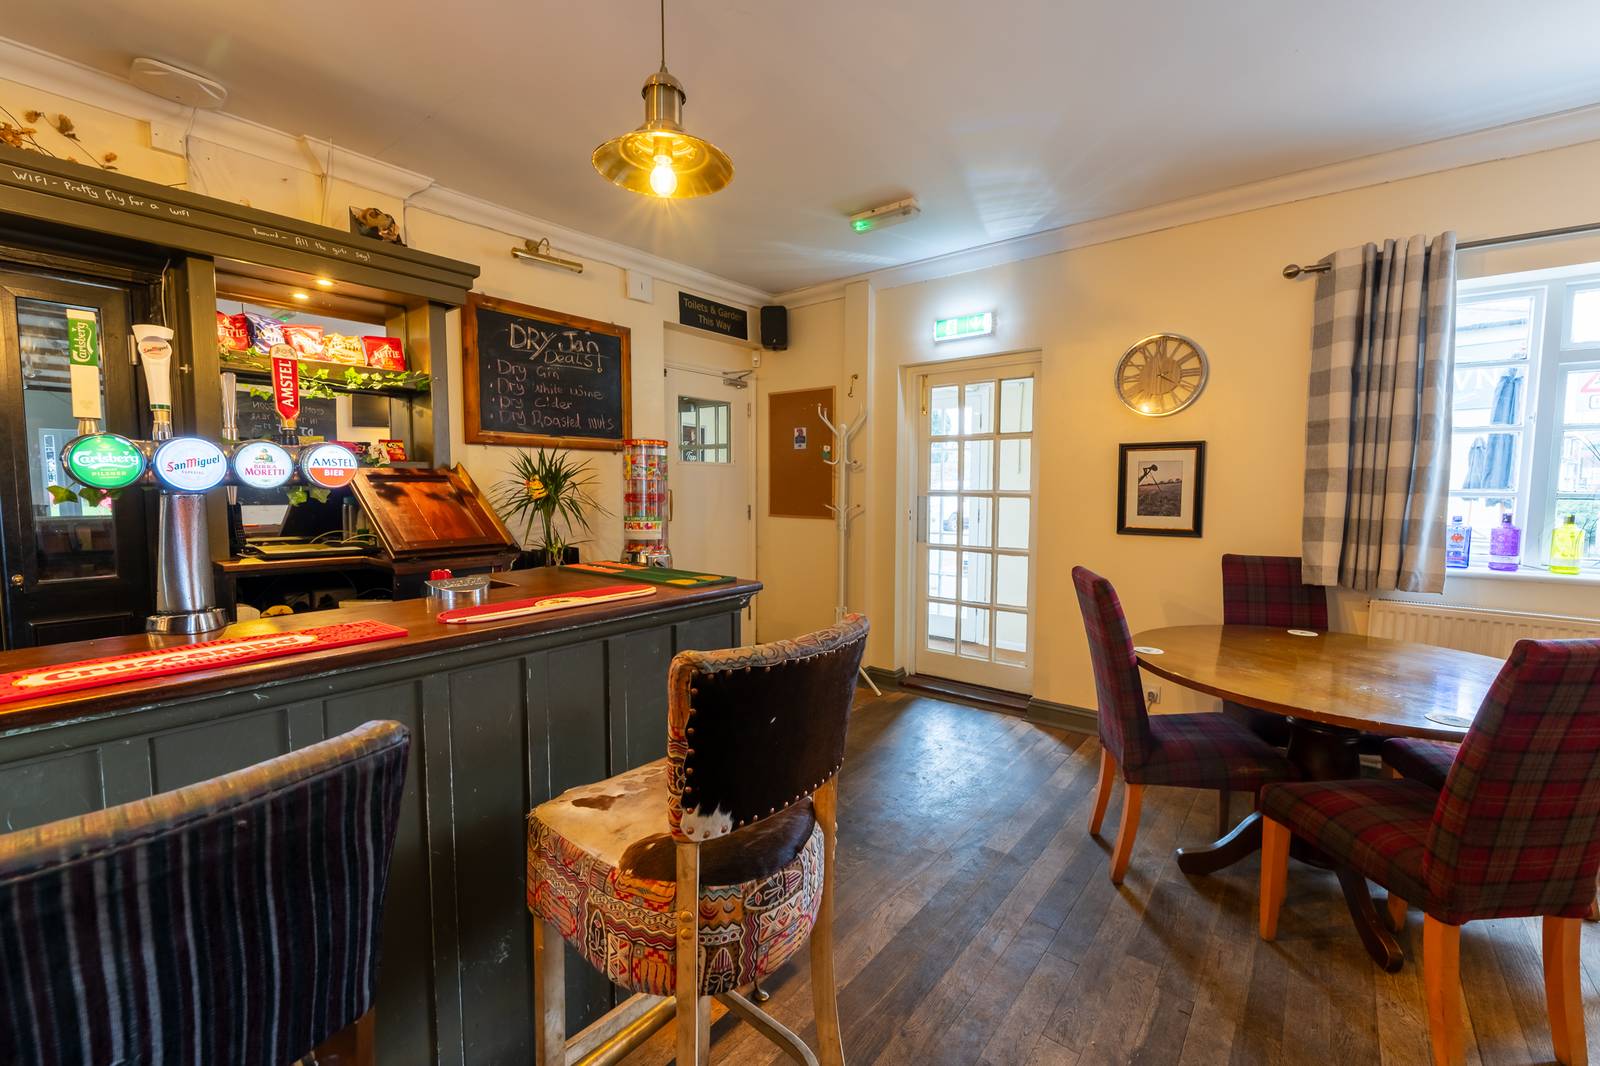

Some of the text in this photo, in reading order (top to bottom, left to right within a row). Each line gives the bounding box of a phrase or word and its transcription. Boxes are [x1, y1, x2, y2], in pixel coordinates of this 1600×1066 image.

[12, 170, 47, 186] WIFI
[64, 181, 99, 199] Pretty
[105, 190, 125, 206] fly
[129, 195, 144, 207] for
[295, 236, 309, 248] All
[683, 297, 708, 313] Toilets
[697, 313, 715, 327] This
[72, 322, 91, 363] Carlsberg
[510, 322, 557, 361] DRY
[497, 359, 560, 382] Dry Gin
[280, 360, 294, 408] AMSTEL
[497, 378, 525, 395] Dry
[500, 397, 525, 409] Dry
[500, 409, 526, 426] Dry
[532, 410, 581, 430] Roasted
[73, 450, 139, 468] Carlsberg
[312, 458, 354, 467] AMSTEL
[244, 468, 285, 477] MORETTI
[324, 469, 344, 477] BIER
